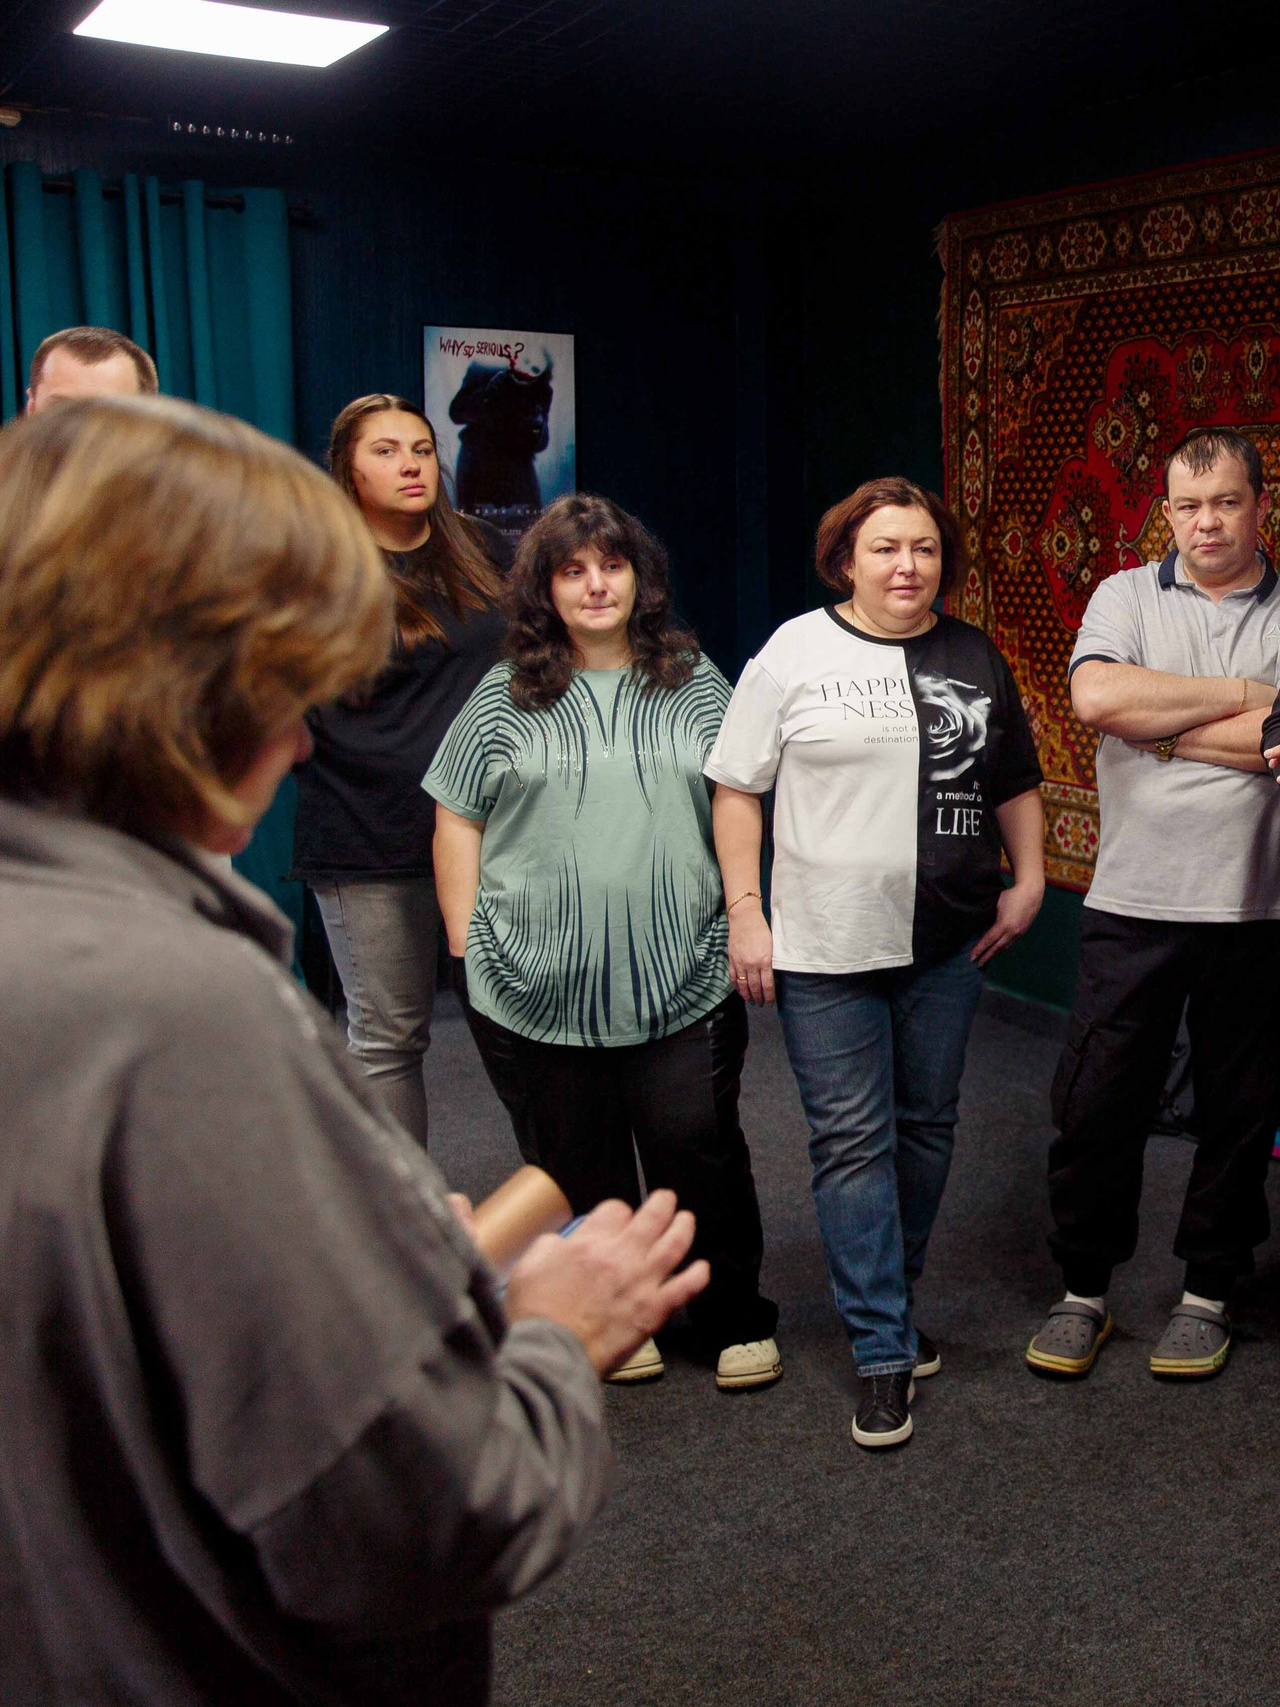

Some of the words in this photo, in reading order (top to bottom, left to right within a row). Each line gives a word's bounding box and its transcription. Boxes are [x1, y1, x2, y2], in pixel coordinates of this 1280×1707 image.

[440, 336, 465, 357] WHY
[463, 345, 475, 359] SO
[476, 340, 525, 360] SERIOUS?
[820, 677, 907, 702] HAPPI
[841, 700, 914, 720] NESS
[882, 725, 890, 733] is
[892, 725, 909, 733] not
[863, 735, 918, 744] destination
[936, 791, 943, 800] a
[935, 807, 983, 836] LIFE
